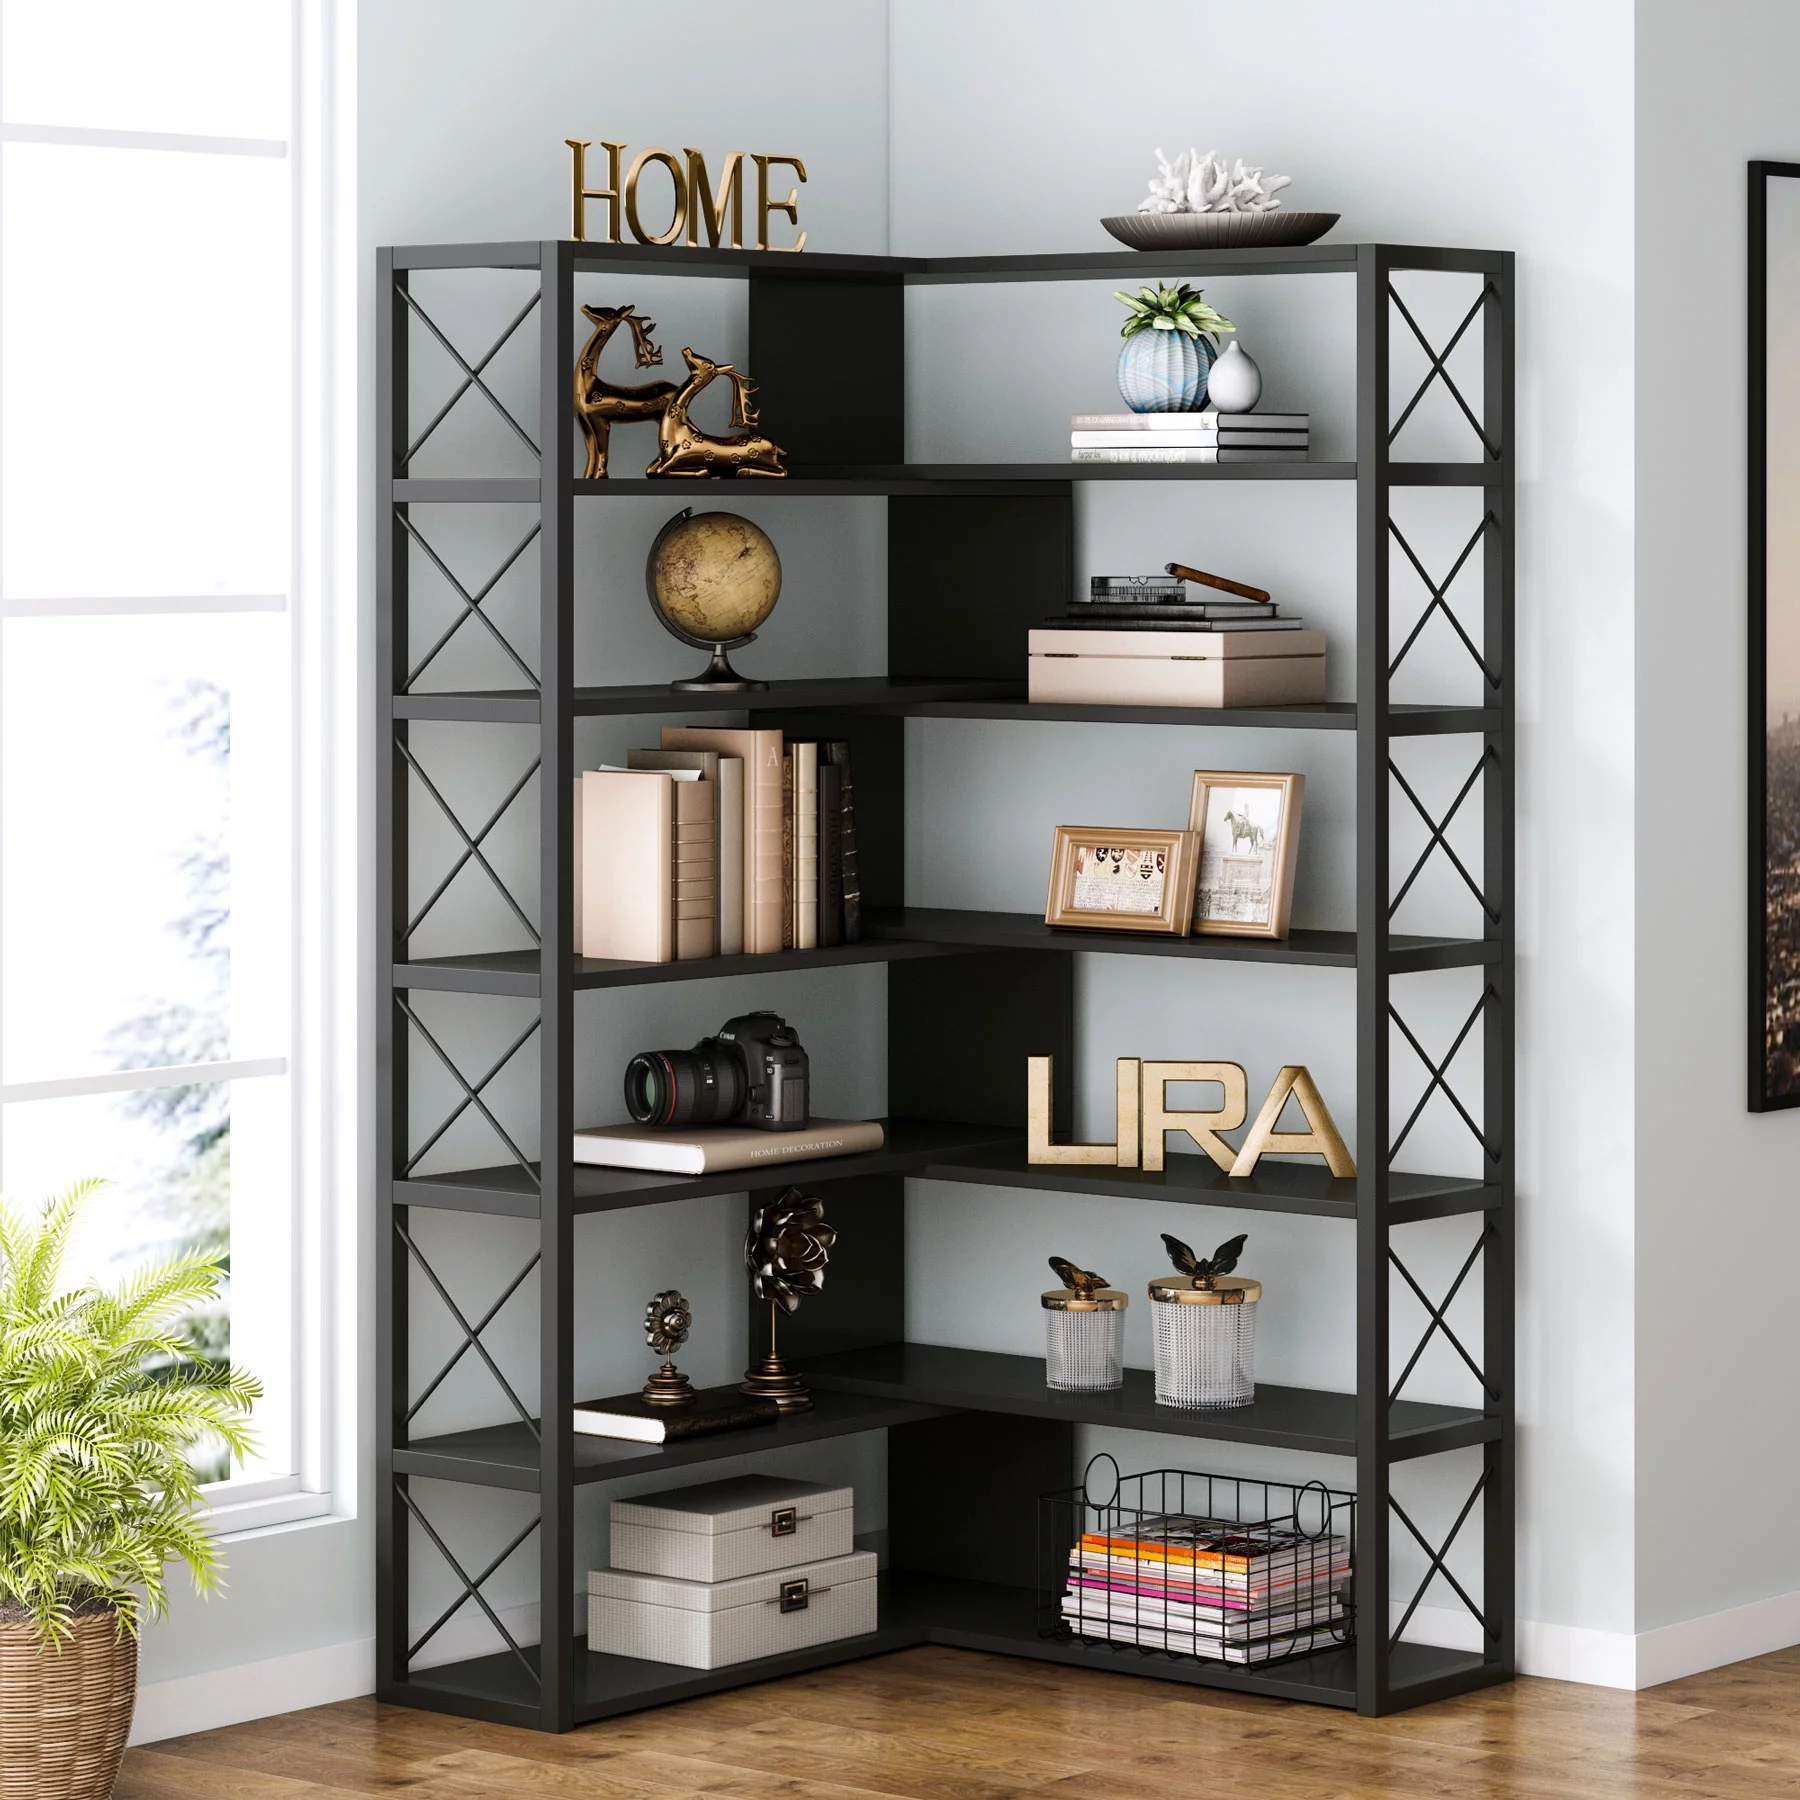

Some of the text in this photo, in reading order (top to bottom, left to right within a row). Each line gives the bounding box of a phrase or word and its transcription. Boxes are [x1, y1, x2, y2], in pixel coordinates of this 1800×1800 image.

[564, 138, 807, 252] HOME
[767, 746, 779, 767] A
[750, 1139, 843, 1158] HOME DECORATION
[1027, 1053, 1358, 1178] LIRA
